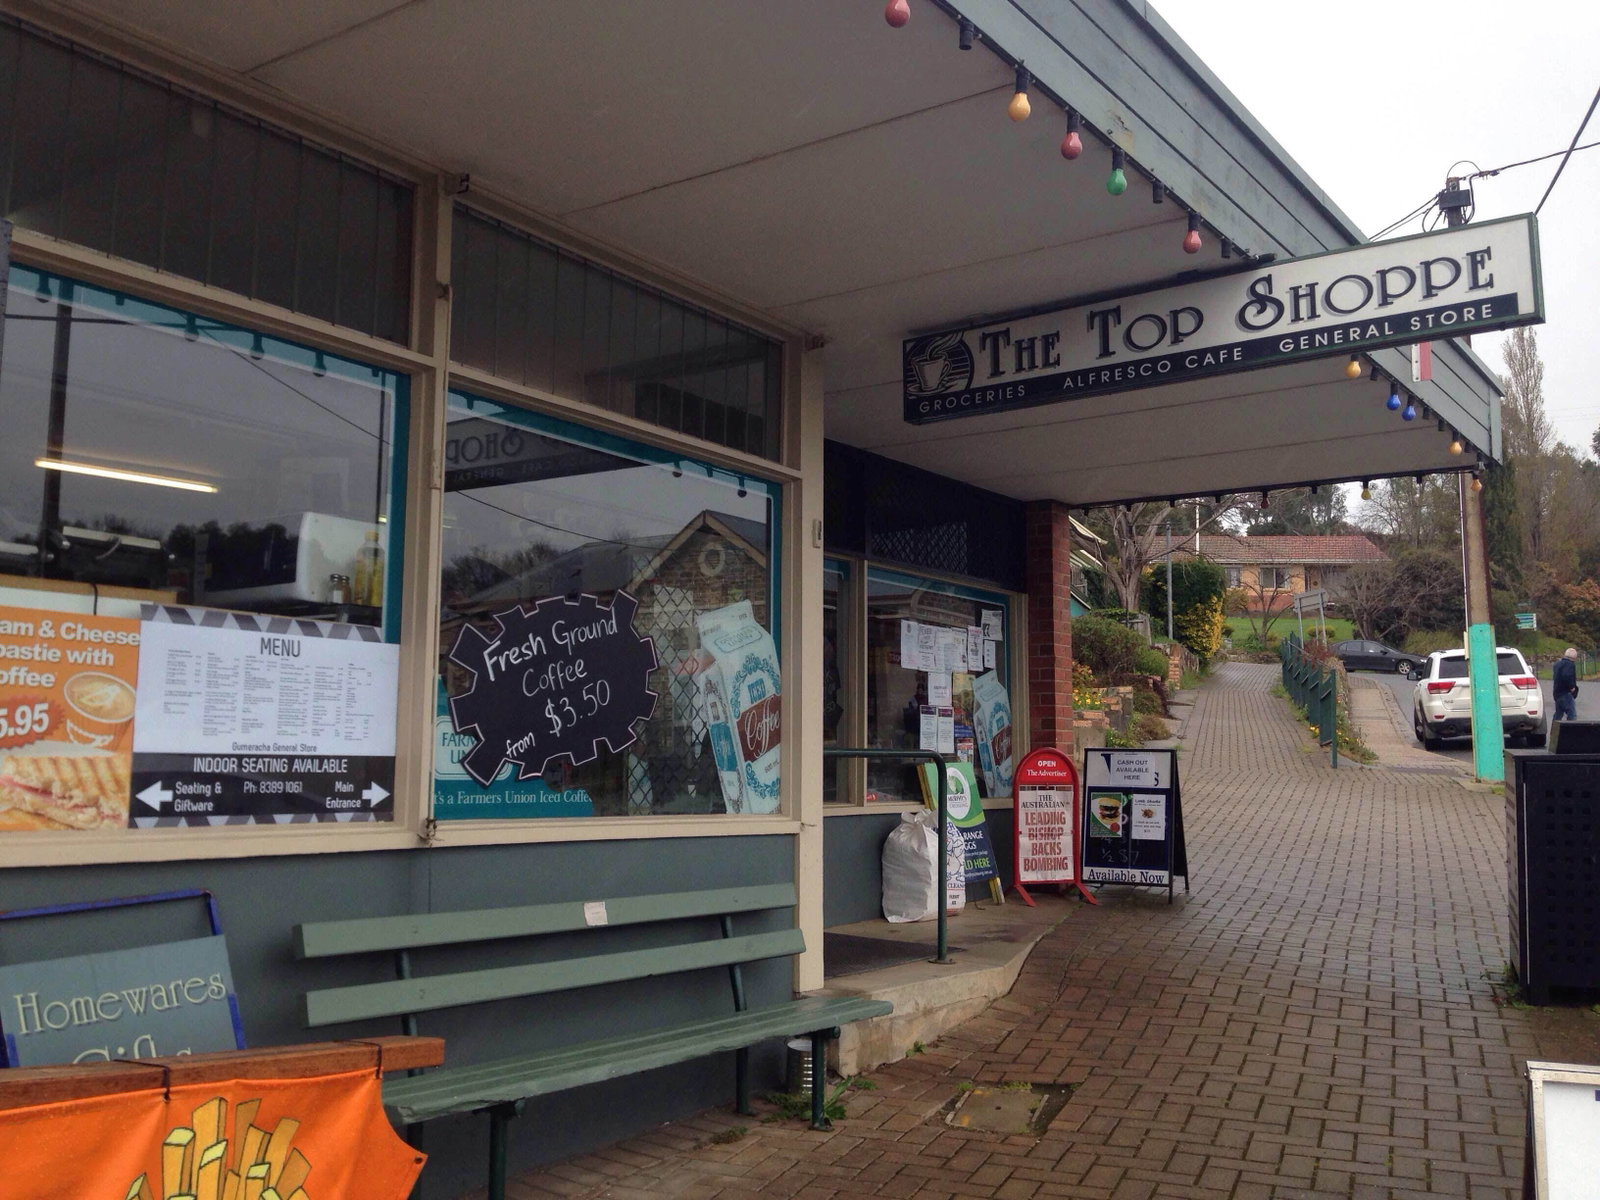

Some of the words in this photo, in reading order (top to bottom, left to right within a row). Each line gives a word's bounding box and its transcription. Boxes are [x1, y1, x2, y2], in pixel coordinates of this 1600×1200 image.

[980, 327, 1060, 379] THE
[1087, 305, 1204, 360] TOP
[1235, 246, 1494, 333] SHOPPE
[918, 384, 1026, 413] GROCERIES
[1063, 360, 1171, 390] ALFRESCO
[1185, 347, 1242, 369] CAFE
[1279, 321, 1394, 352] GENERAL
[1410, 303, 1493, 331] STORE
[38, 619, 56, 639] &
[60, 621, 141, 646] Cheese
[260, 637, 301, 658] MENU
[483, 633, 547, 681] Fresh
[552, 607, 618, 656] Ground
[65, 647, 115, 666] with
[522, 659, 588, 697] Coffee
[506, 731, 536, 758] from
[545, 679, 610, 738] $3.50
[231, 741, 271, 753] Gumeracha
[272, 742, 298, 753] General
[300, 743, 317, 753] Store
[193, 757, 238, 773] INDOOR
[241, 758, 289, 773] SEATING
[291, 758, 348, 773] AVAILABLE
[1038, 769, 1067, 777] Advertiser
[175, 781, 212, 796] Seating
[214, 781, 222, 794] &
[243, 781, 258, 794] Ph:
[259, 781, 284, 794] 8389
[285, 781, 303, 793] 1061
[334, 781, 354, 793] Main
[325, 797, 362, 809] Entrance
[447, 794, 455, 804] a
[457, 791, 502, 804] Farmers
[505, 791, 537, 804] Union
[563, 789, 593, 803] Coffe
[1038, 794, 1053, 802] THE
[174, 799, 213, 813] Giftware
[1021, 801, 1065, 809] AUSTRALIAN
[1025, 811, 1066, 826] LEADING
[962, 830, 983, 841] RANGE
[1028, 827, 1064, 841] BISHOP
[1031, 841, 1062, 856] BACKS
[974, 857, 991, 869] HERE
[1023, 857, 1069, 872] BOMBING
[1087, 868, 1136, 882] Available
[1139, 871, 1165, 884] Now
[13, 972, 227, 1035] Homewares
